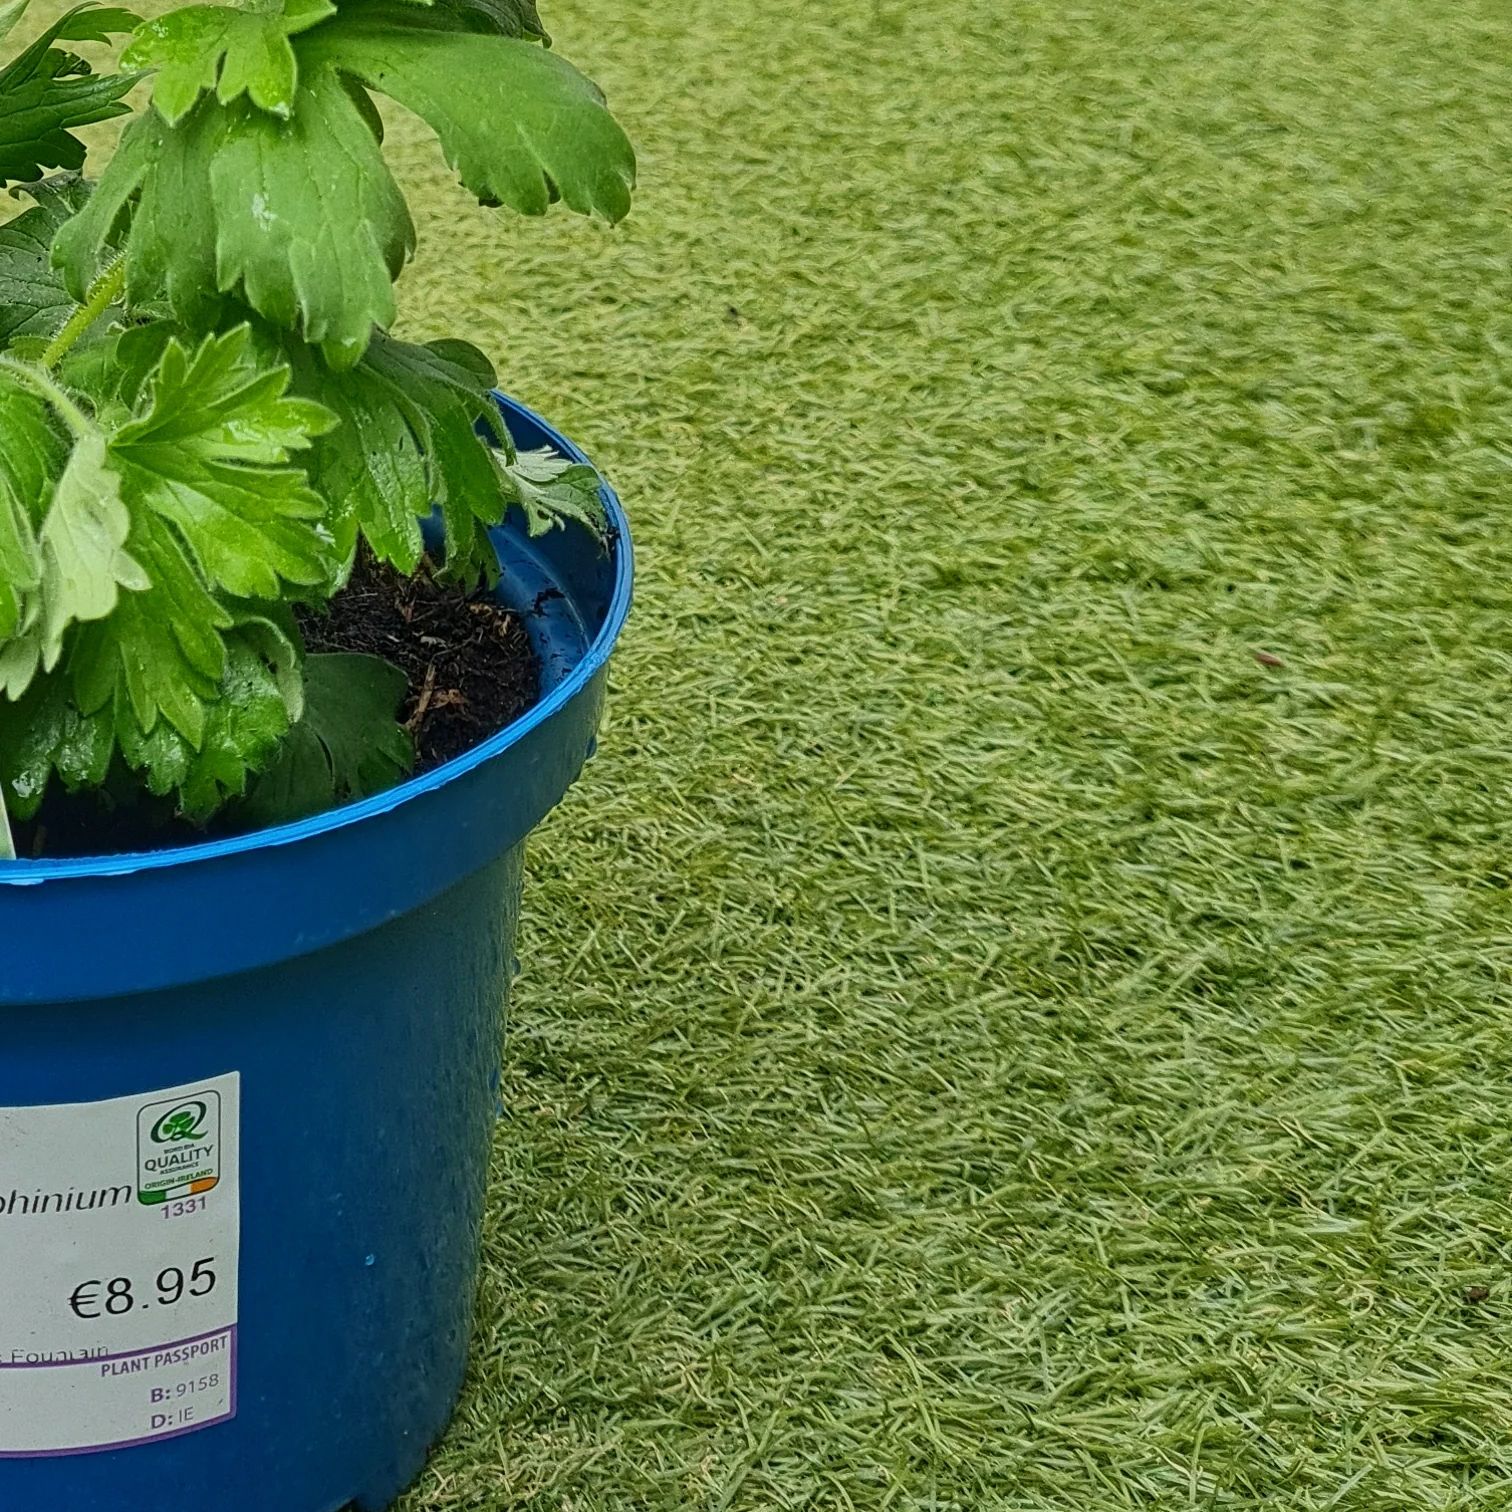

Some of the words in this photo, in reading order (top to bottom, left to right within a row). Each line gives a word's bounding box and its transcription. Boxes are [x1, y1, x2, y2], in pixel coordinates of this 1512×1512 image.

[144, 1144, 214, 1172] QUALITY
[160, 1196, 207, 1219] 1331
[67, 1257, 217, 1319] €8.95
[101, 1356, 149, 1377] PLANT
[154, 1335, 227, 1368] PASSPORT
[150, 1387, 171, 1403] B:
[176, 1373, 219, 1397] 9158
[150, 1413, 173, 1429] D:
[179, 1406, 194, 1423] IE
